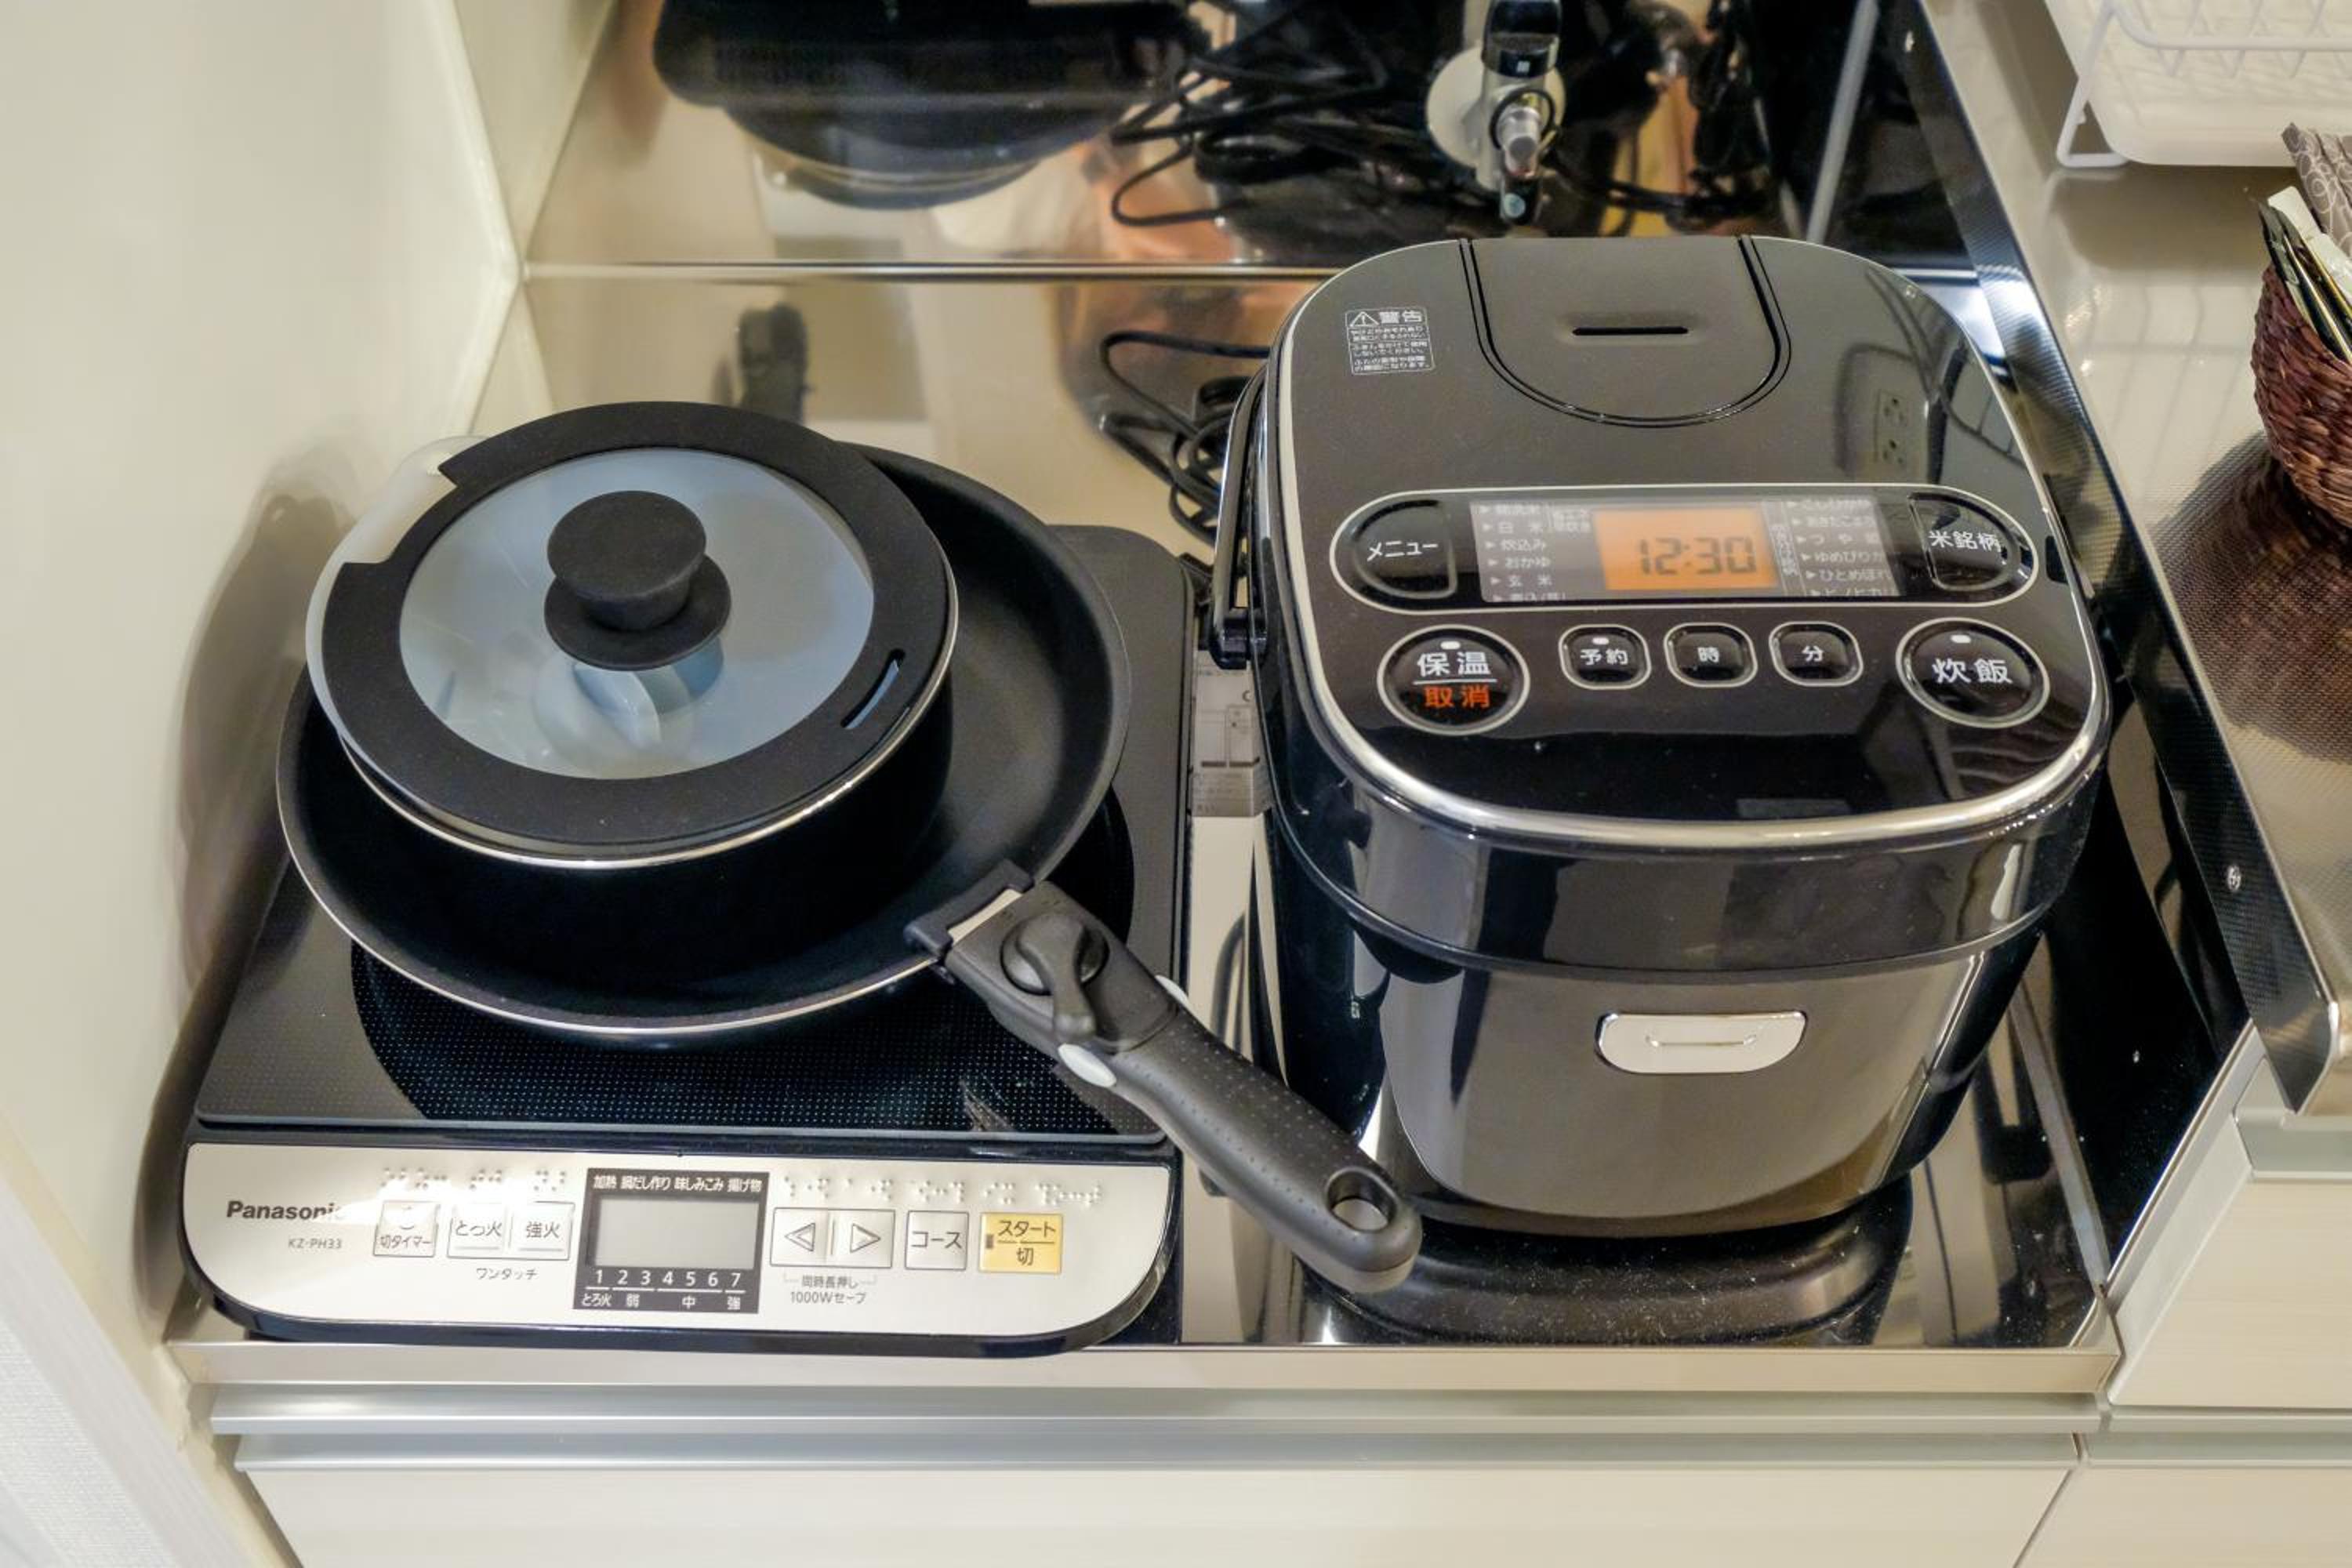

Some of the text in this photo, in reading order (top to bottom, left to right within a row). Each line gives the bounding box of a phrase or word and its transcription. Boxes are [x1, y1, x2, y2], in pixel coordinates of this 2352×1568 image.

[1367, 540, 1439, 561] メニュー
[1928, 530, 2002, 553] 米銘柄
[1640, 536, 1758, 575] 12:30
[1580, 648, 1629, 666] 予約
[1697, 646, 1720, 663] 時
[1802, 645, 1824, 662] 分
[1417, 652, 1492, 677] 保温
[1932, 658, 2013, 684] 炊飯
[1423, 684, 1490, 708] 取消
[227, 1200, 343, 1220] Panasoni
[525, 1221, 561, 1239] 強火
[997, 1219, 1057, 1239] スタート
[288, 1238, 343, 1250] KZ-PH33
[379, 1234, 433, 1249] 切タイマー
[911, 1230, 963, 1250] コース
[1016, 1247, 1034, 1265] 切
[476, 1267, 538, 1280] ワンタッチ
[596, 1269, 742, 1287] 1 2 3 4 5 6 7
[625, 1294, 641, 1309] 弱
[681, 1295, 696, 1309] 中
[726, 1296, 741, 1310] 強
